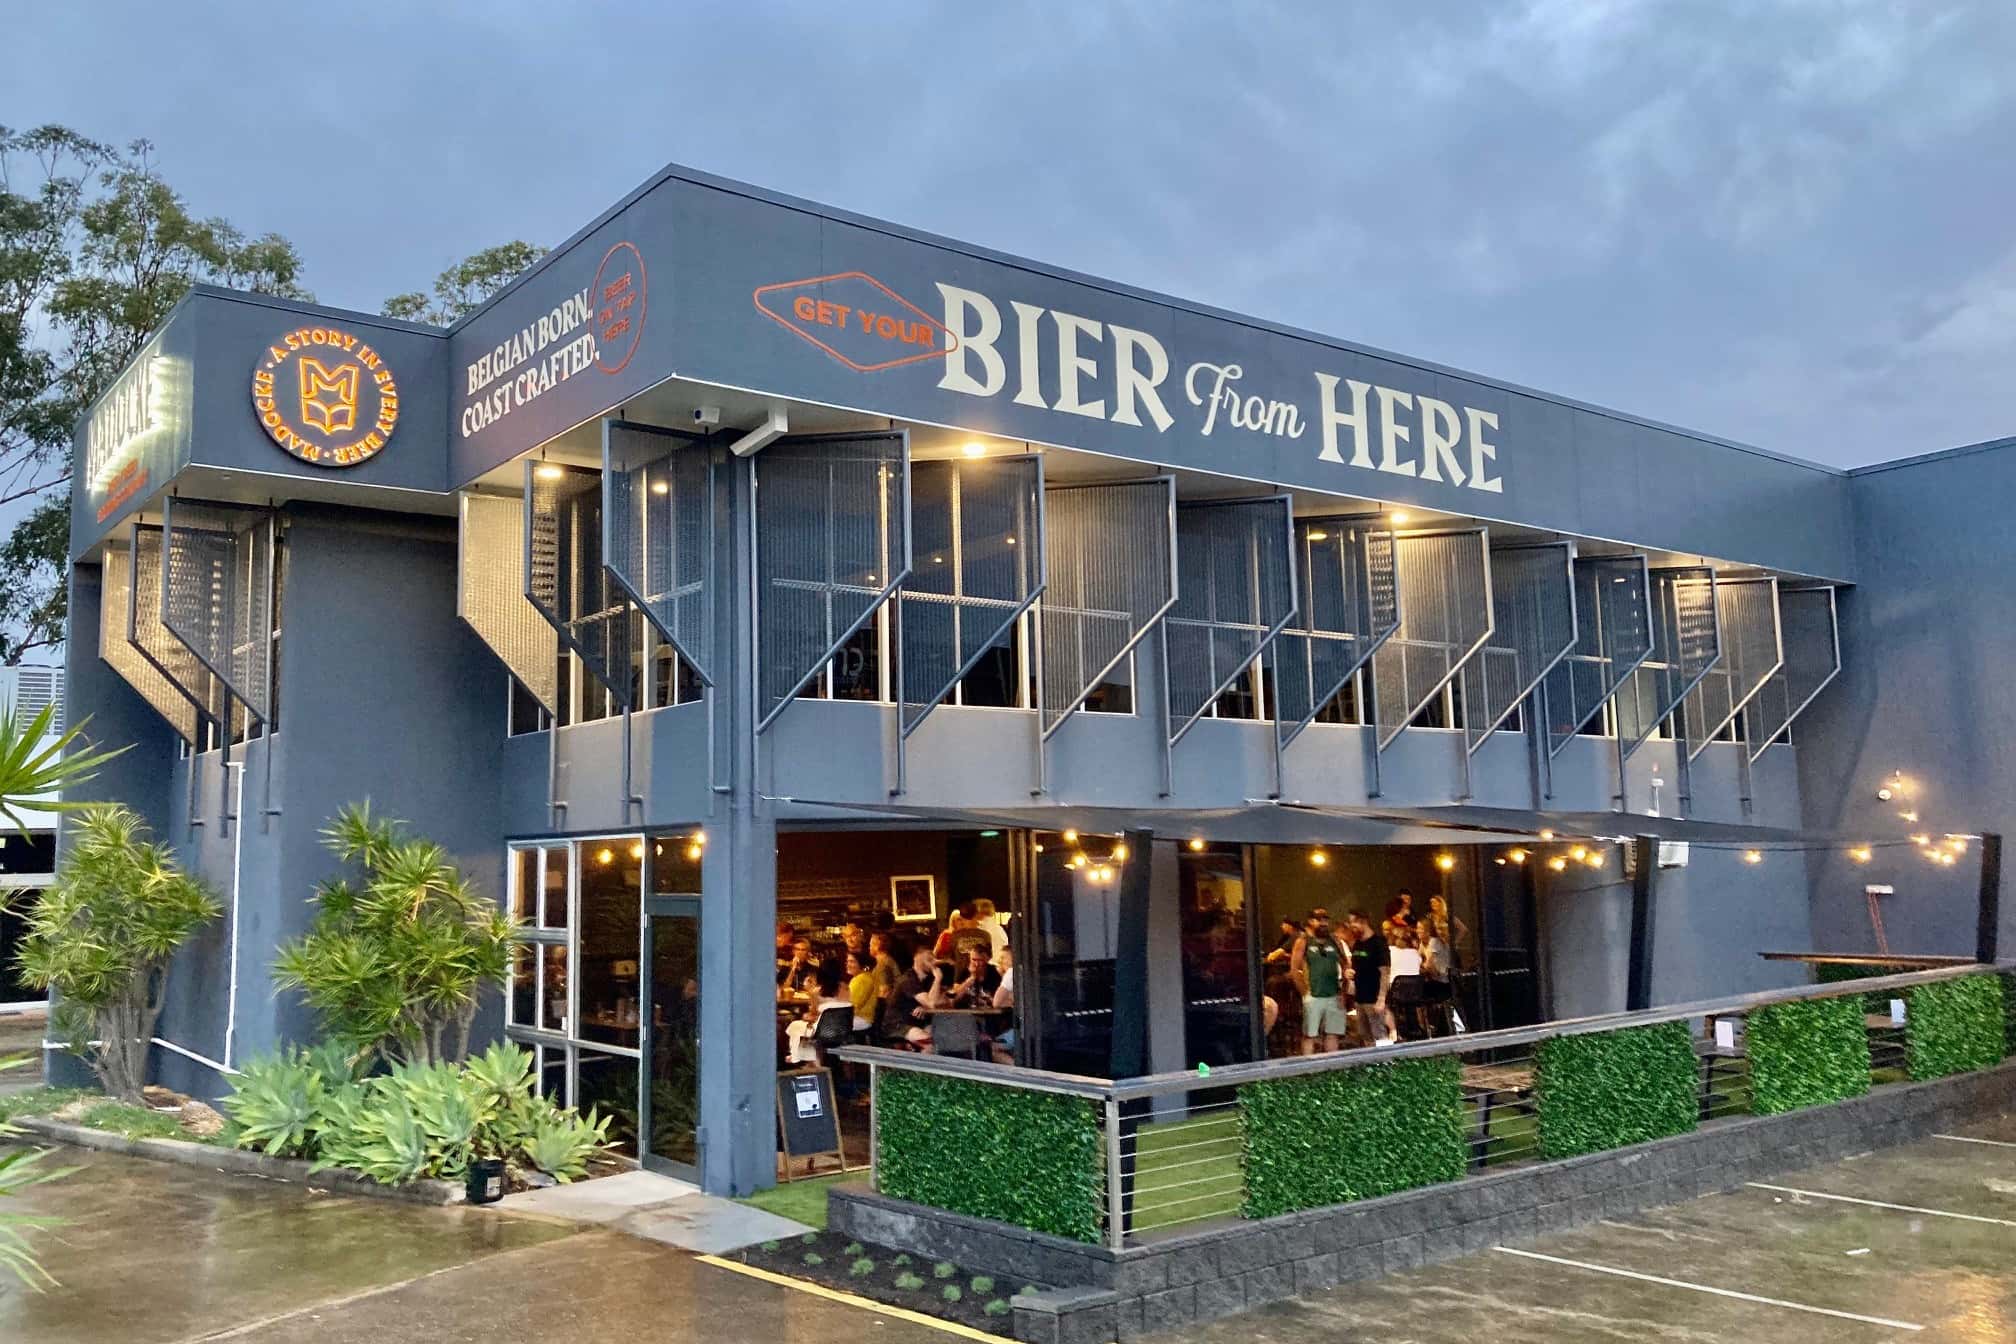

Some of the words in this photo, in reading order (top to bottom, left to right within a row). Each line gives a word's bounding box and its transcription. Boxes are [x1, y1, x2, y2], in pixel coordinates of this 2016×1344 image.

[284, 329, 358, 352] STORY
[467, 323, 536, 396] BELGIAN
[538, 288, 594, 352] BORN.
[793, 296, 850, 330] GET
[857, 309, 935, 348] YOUR
[270, 346, 289, 364] A
[356, 345, 382, 370] IN
[374, 370, 398, 436] EVERY
[461, 380, 513, 438] COAST
[514, 332, 600, 407] CRAFTED.
[935, 282, 1175, 433] BIER
[1185, 362, 1306, 439] From
[1314, 371, 1503, 493] HERE
[254, 370, 322, 461] MADOCKE
[333, 432, 384, 464] BEER
